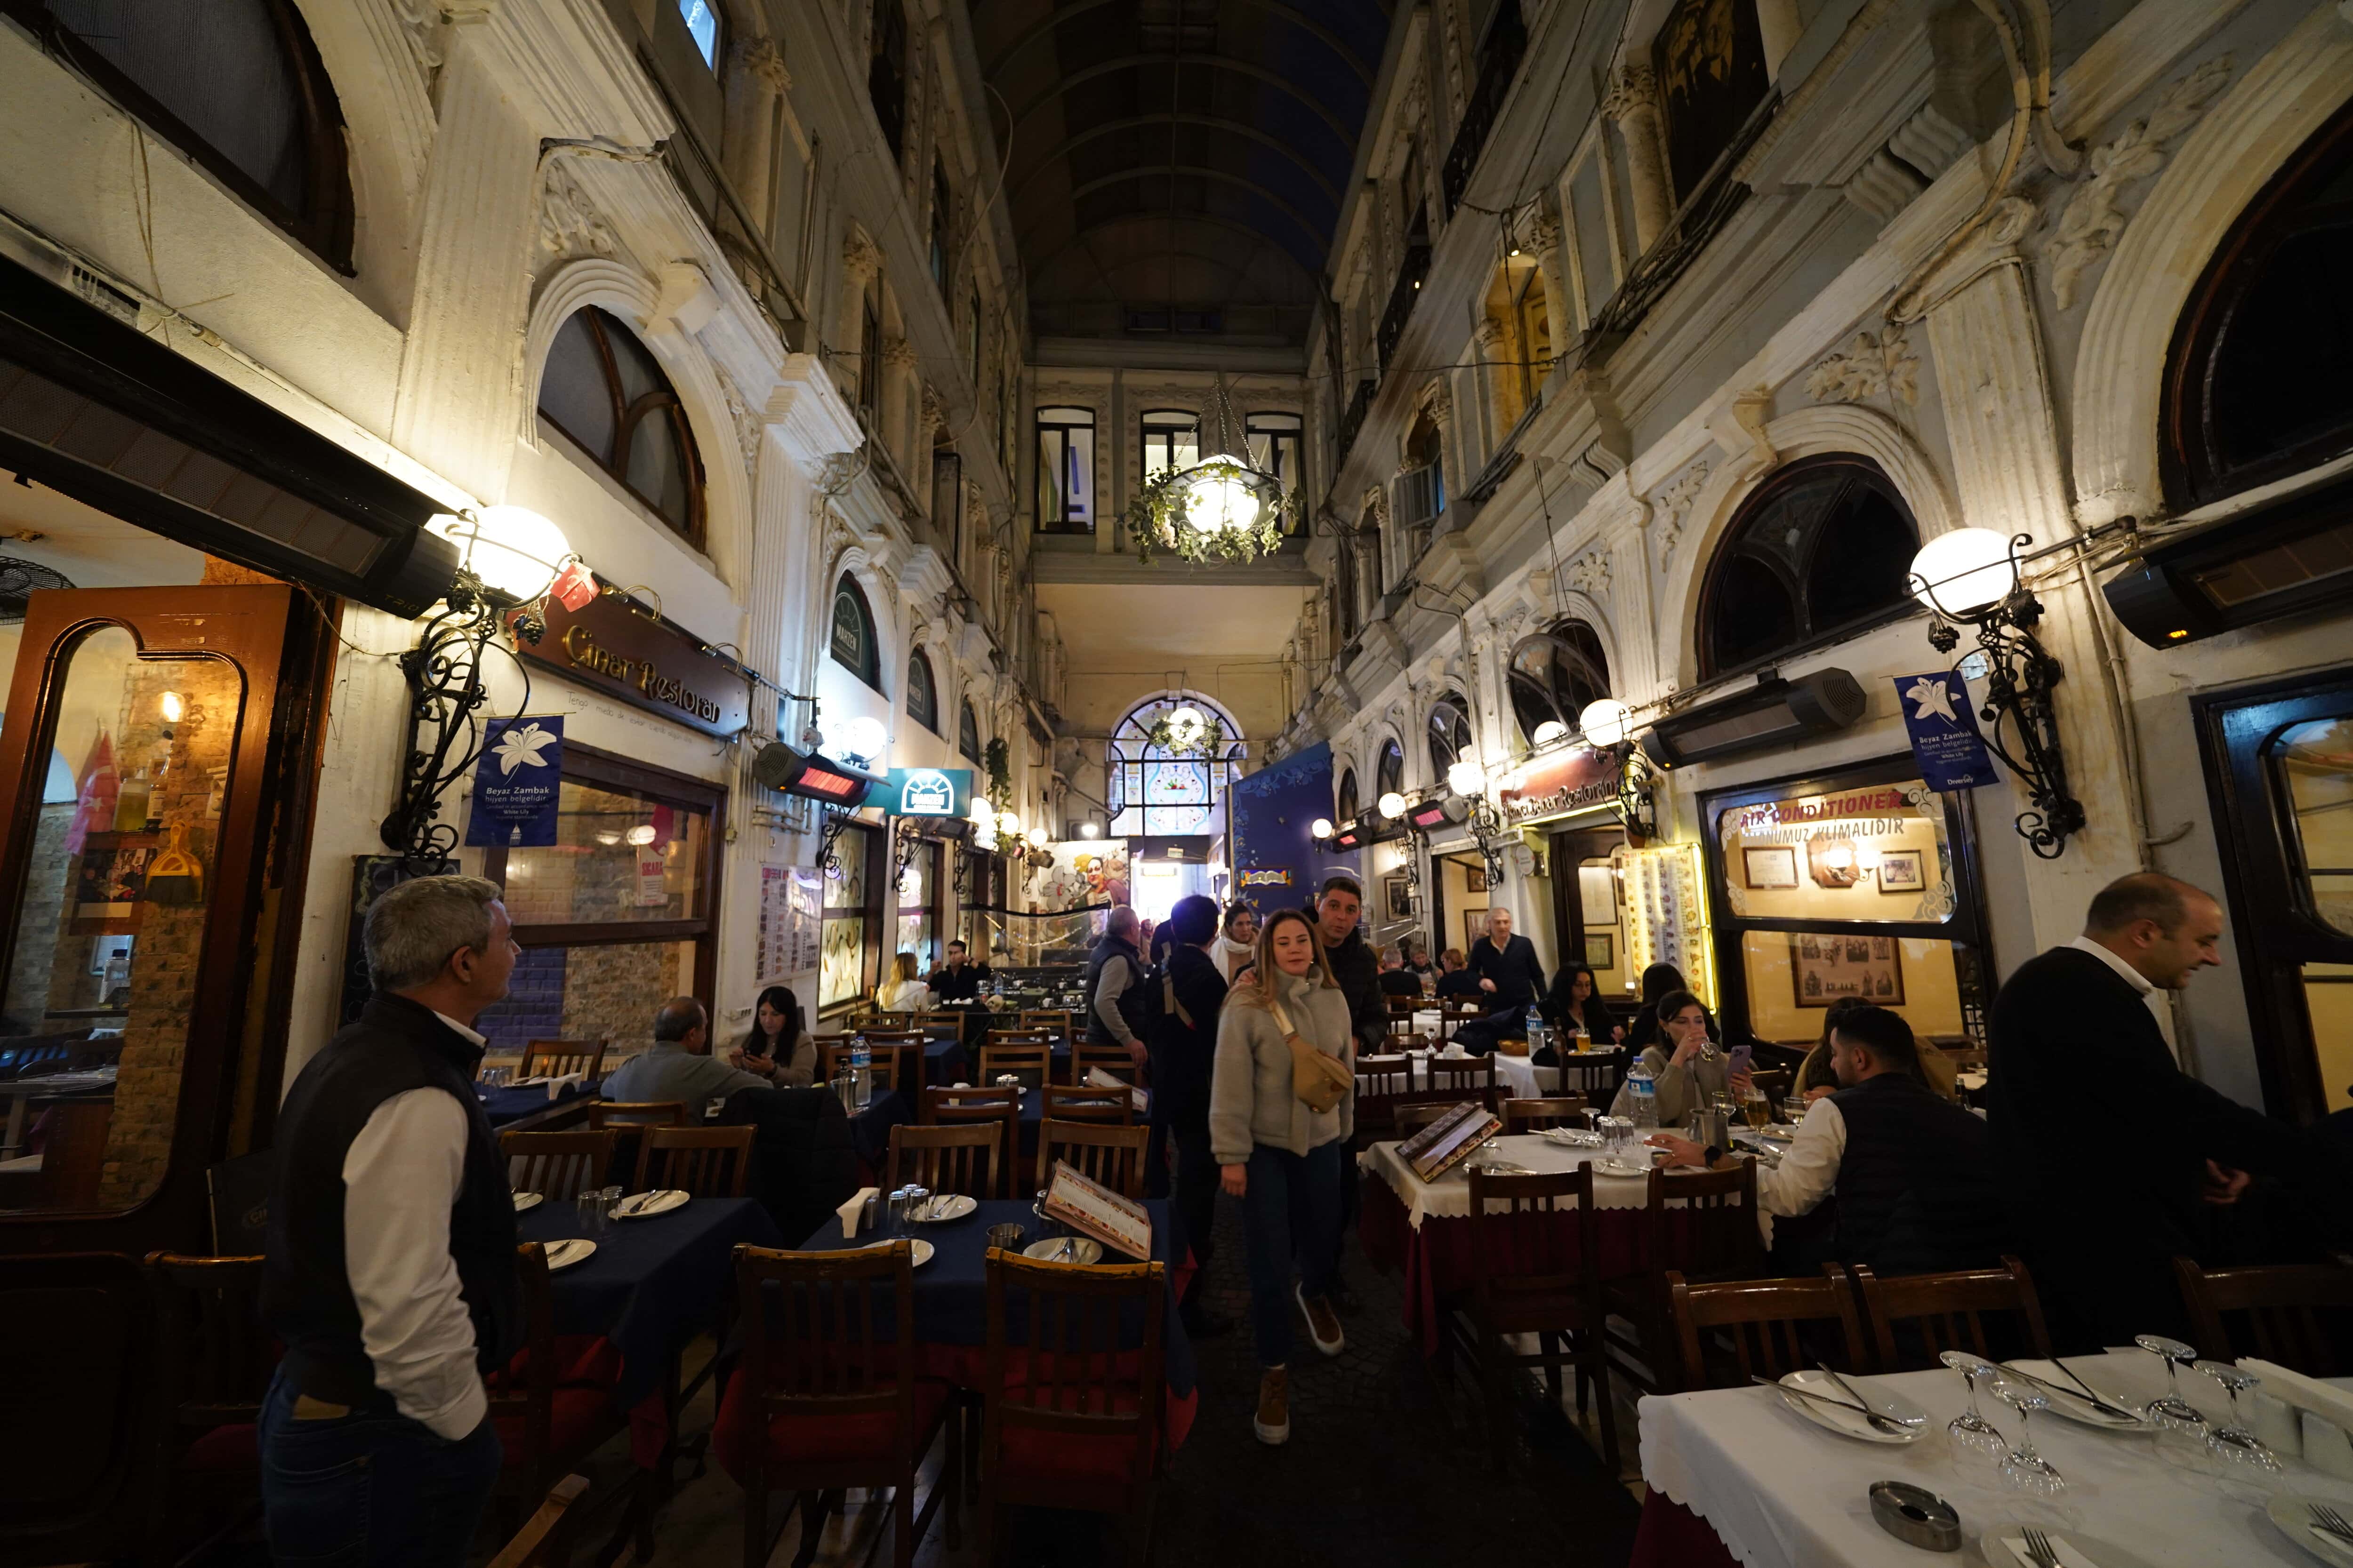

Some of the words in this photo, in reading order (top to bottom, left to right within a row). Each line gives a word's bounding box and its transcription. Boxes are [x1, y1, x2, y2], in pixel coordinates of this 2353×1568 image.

[836, 623, 857, 652] MAHZEN
[639, 661, 721, 723] Restoran
[1919, 736, 1940, 744] Beyaz
[1942, 730, 1972, 740] Zambak
[1947, 776, 1973, 785] Diversey
[485, 794, 507, 803] hijyen
[486, 787, 511, 796] Beyaz
[1558, 780, 1616, 809] Restoran
[1740, 811, 1766, 828] AIR
[1771, 791, 1903, 823] CONDITIONER
